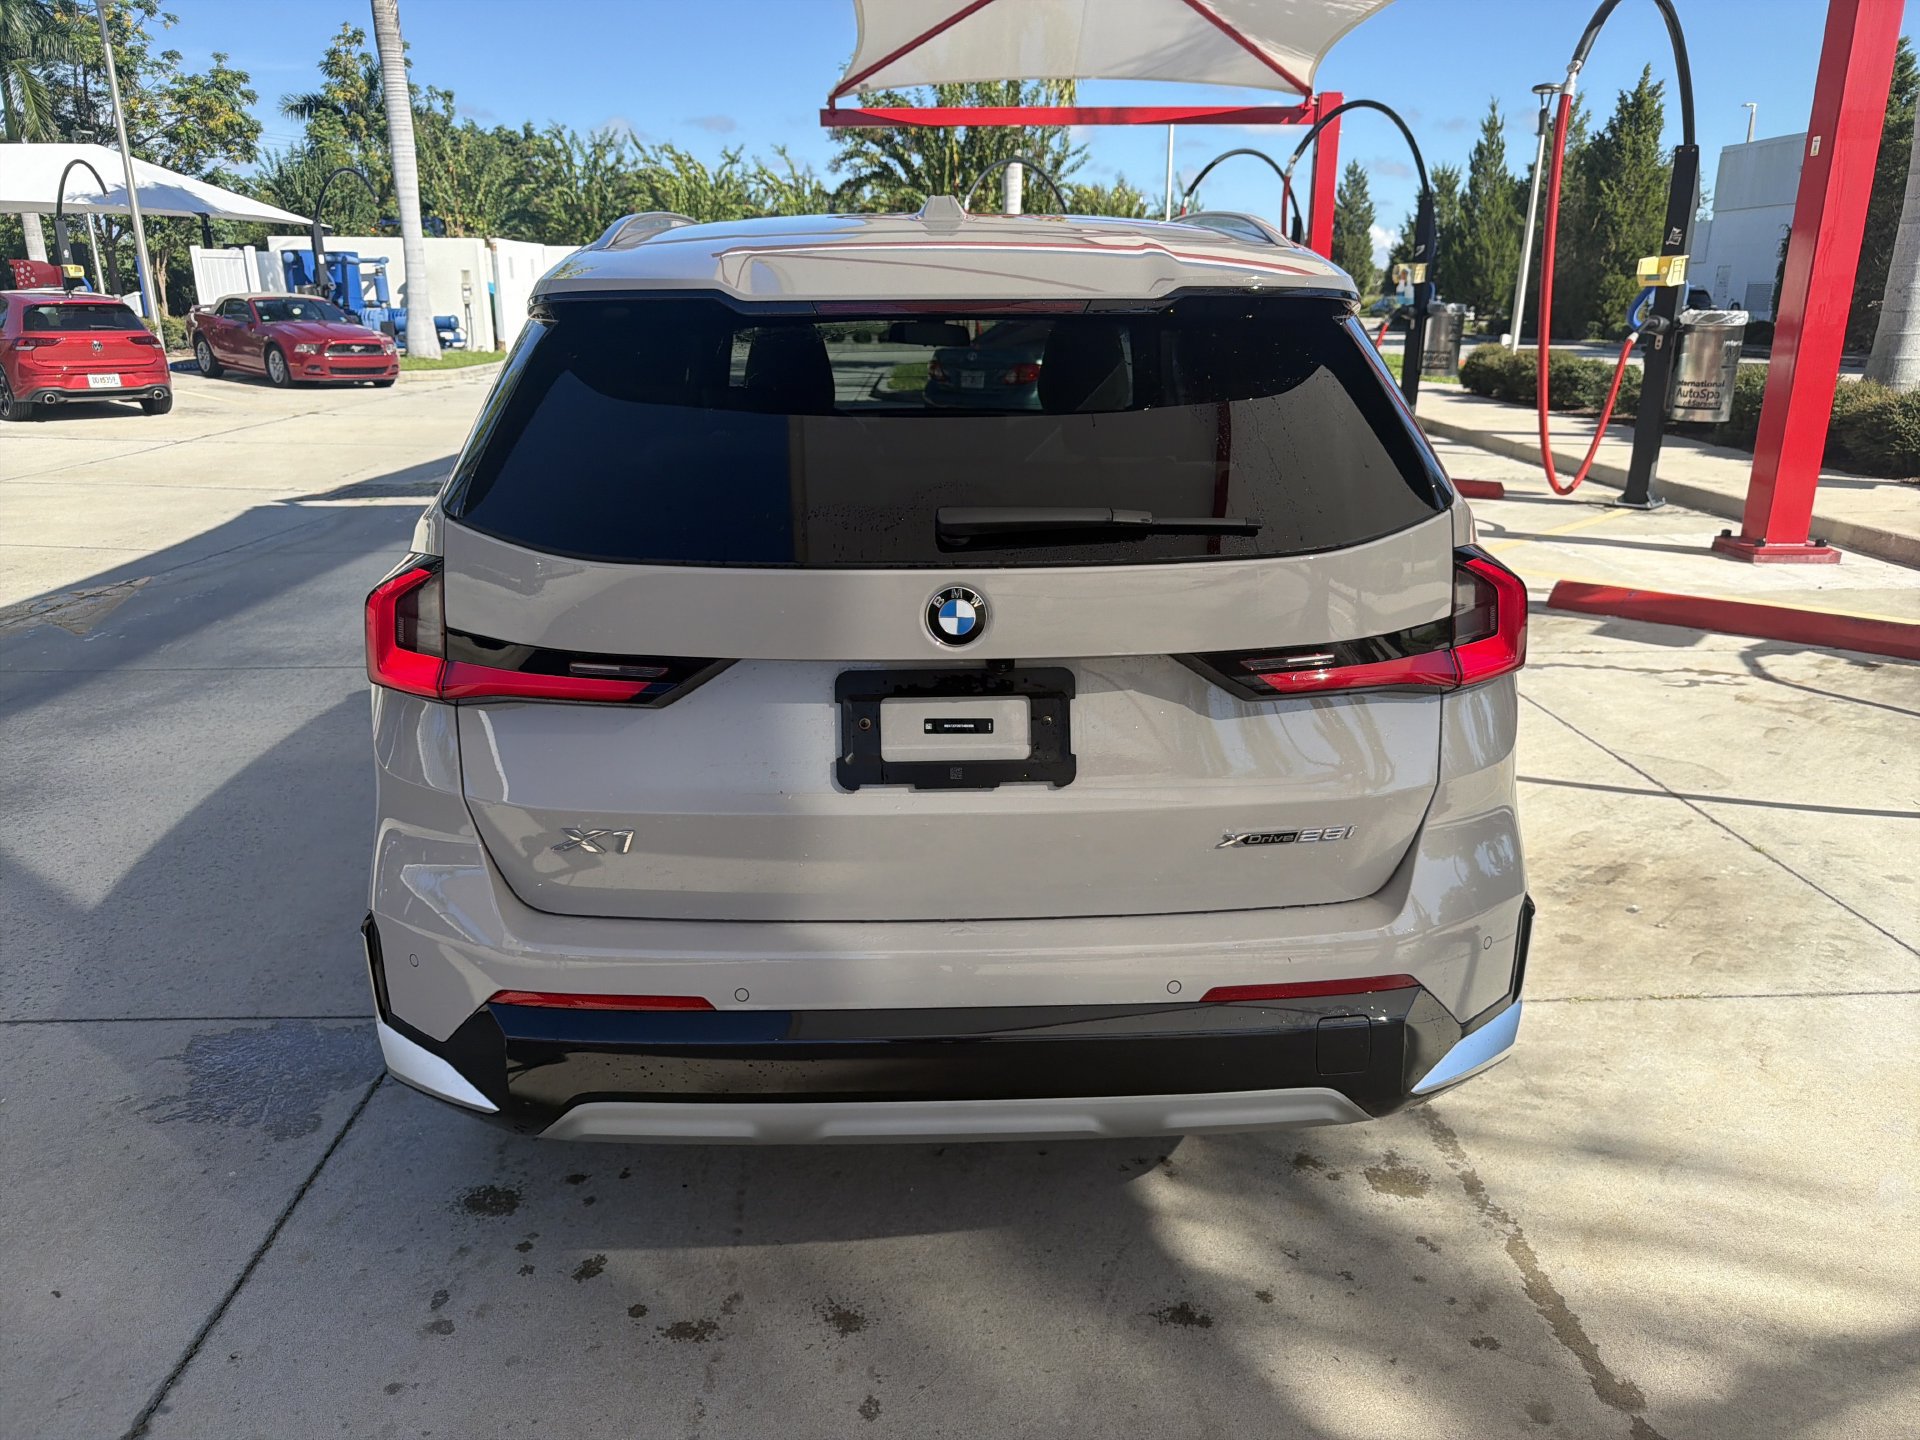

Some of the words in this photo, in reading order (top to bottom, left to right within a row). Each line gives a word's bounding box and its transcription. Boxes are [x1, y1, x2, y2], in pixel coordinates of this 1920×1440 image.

[1676, 380, 1725, 388] nternational
[1676, 387, 1720, 400] AutoSpa
[933, 588, 983, 609] BMW
[550, 828, 634, 854] X1
